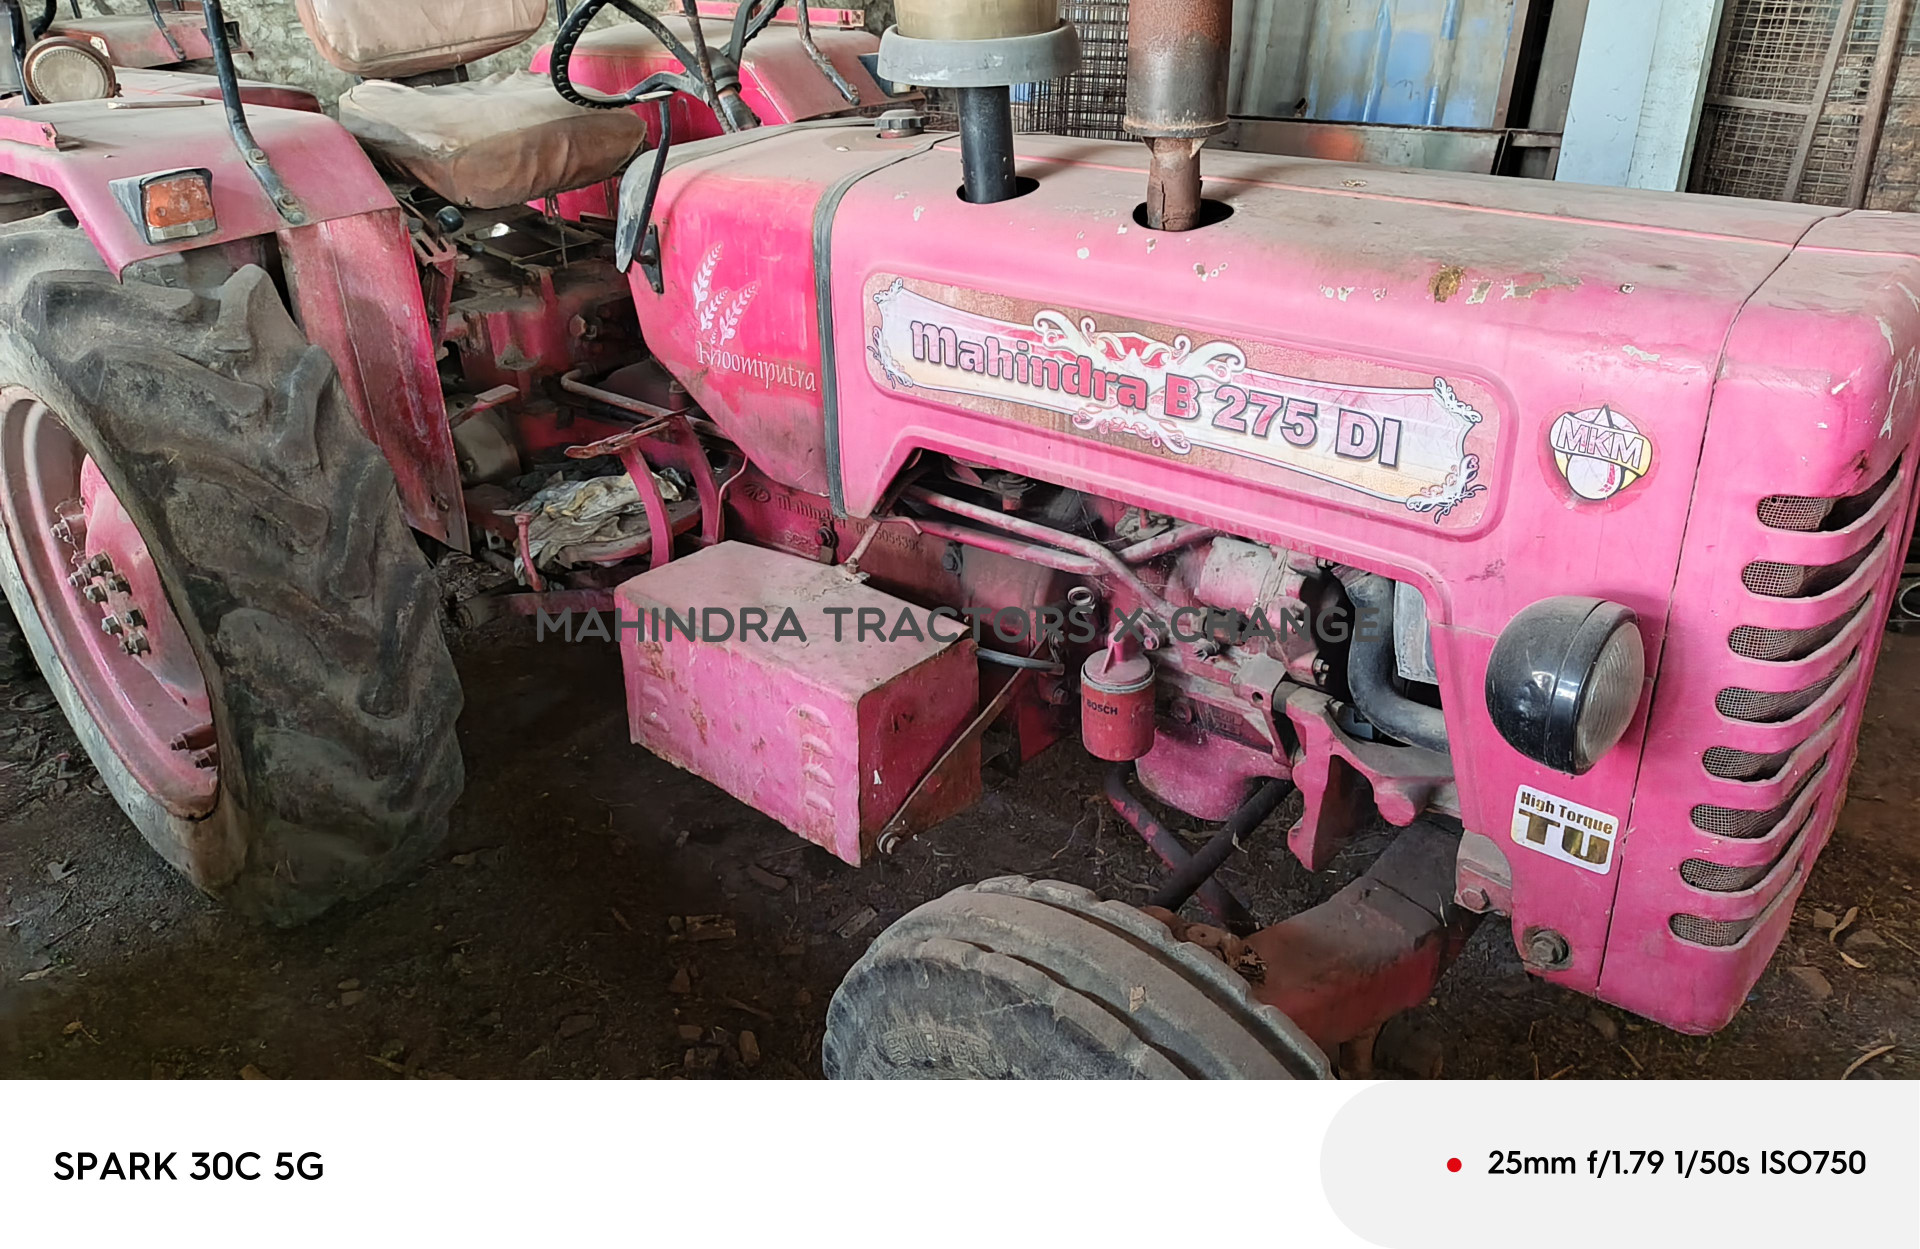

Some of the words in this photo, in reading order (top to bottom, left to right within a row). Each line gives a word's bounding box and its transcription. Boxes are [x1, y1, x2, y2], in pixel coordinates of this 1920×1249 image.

[910, 320, 1148, 411] Mahindra
[1163, 372, 1201, 421] B
[1211, 383, 1320, 446] 275
[1334, 407, 1402, 468] DI
[1555, 415, 1645, 471] MKM
[1086, 698, 1118, 715] BOSCH
[1518, 807, 1610, 865] TU
[1520, 791, 1555, 814] High
[1559, 804, 1613, 834] Torque
